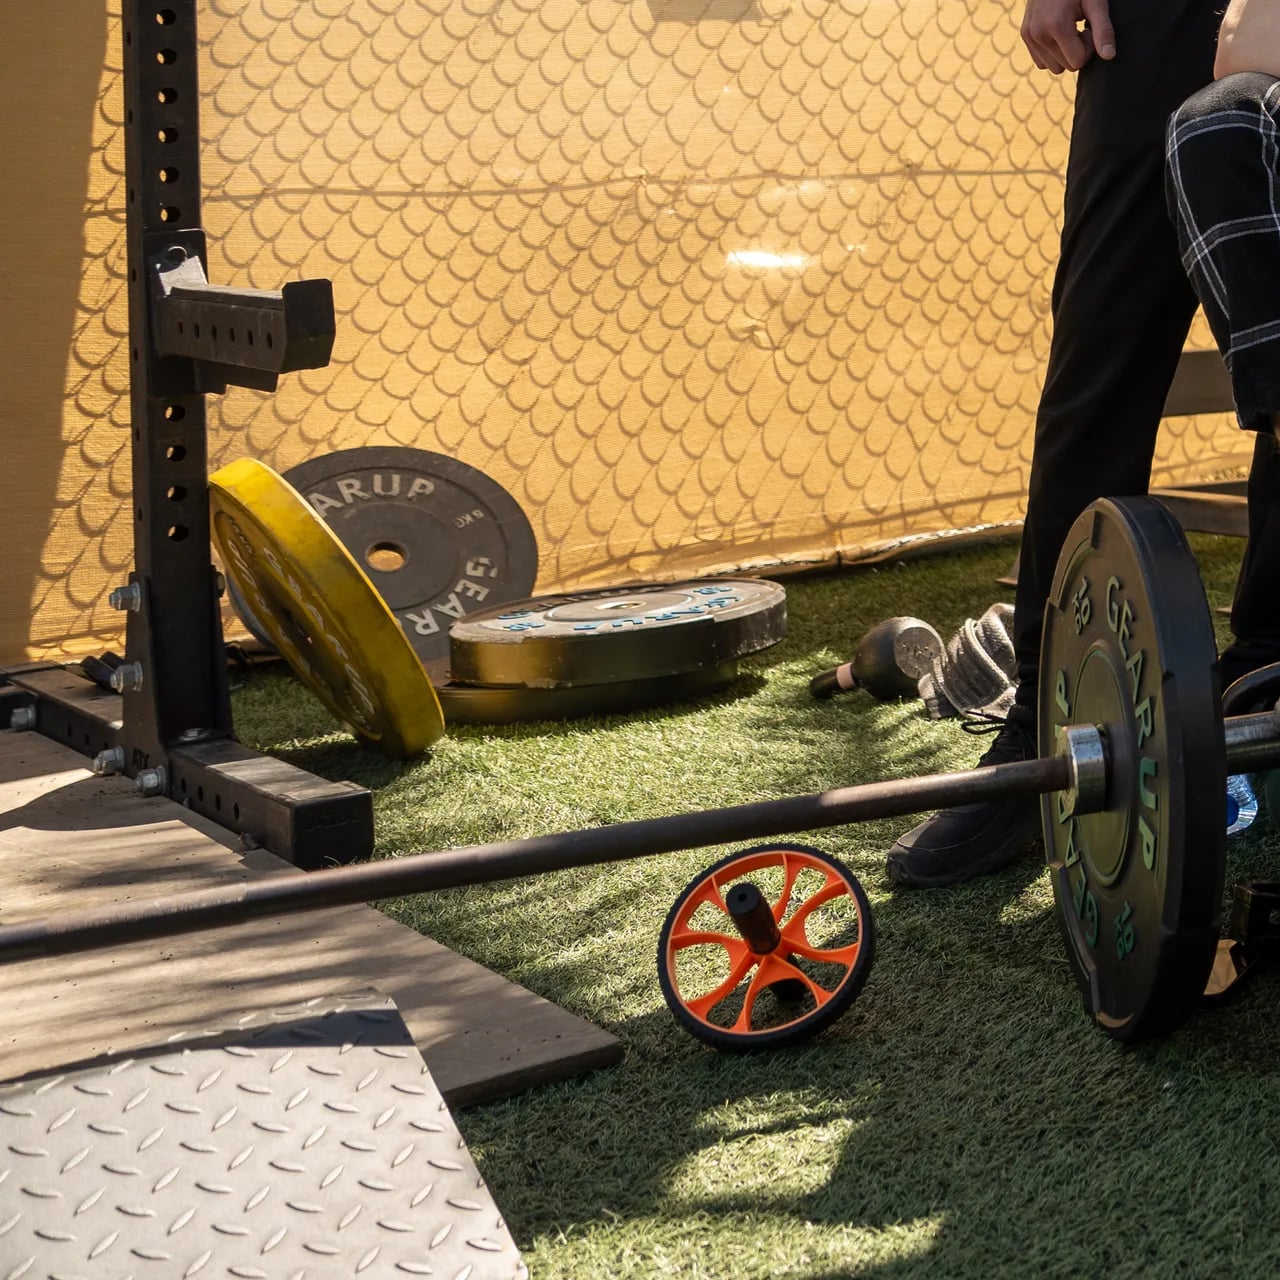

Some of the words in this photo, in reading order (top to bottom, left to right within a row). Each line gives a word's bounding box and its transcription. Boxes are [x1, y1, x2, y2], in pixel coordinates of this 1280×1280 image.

[307, 473, 435, 518] ARUP
[453, 513, 475, 529] KG
[405, 557, 498, 636] GEAR
[1072, 592, 1083, 636] KG
[1079, 576, 1092, 625] 10
[1106, 576, 1157, 871] GEARUP
[1055, 670, 1098, 948] GEARP
[1113, 914, 1126, 961] KG
[1121, 900, 1135, 954] 10
